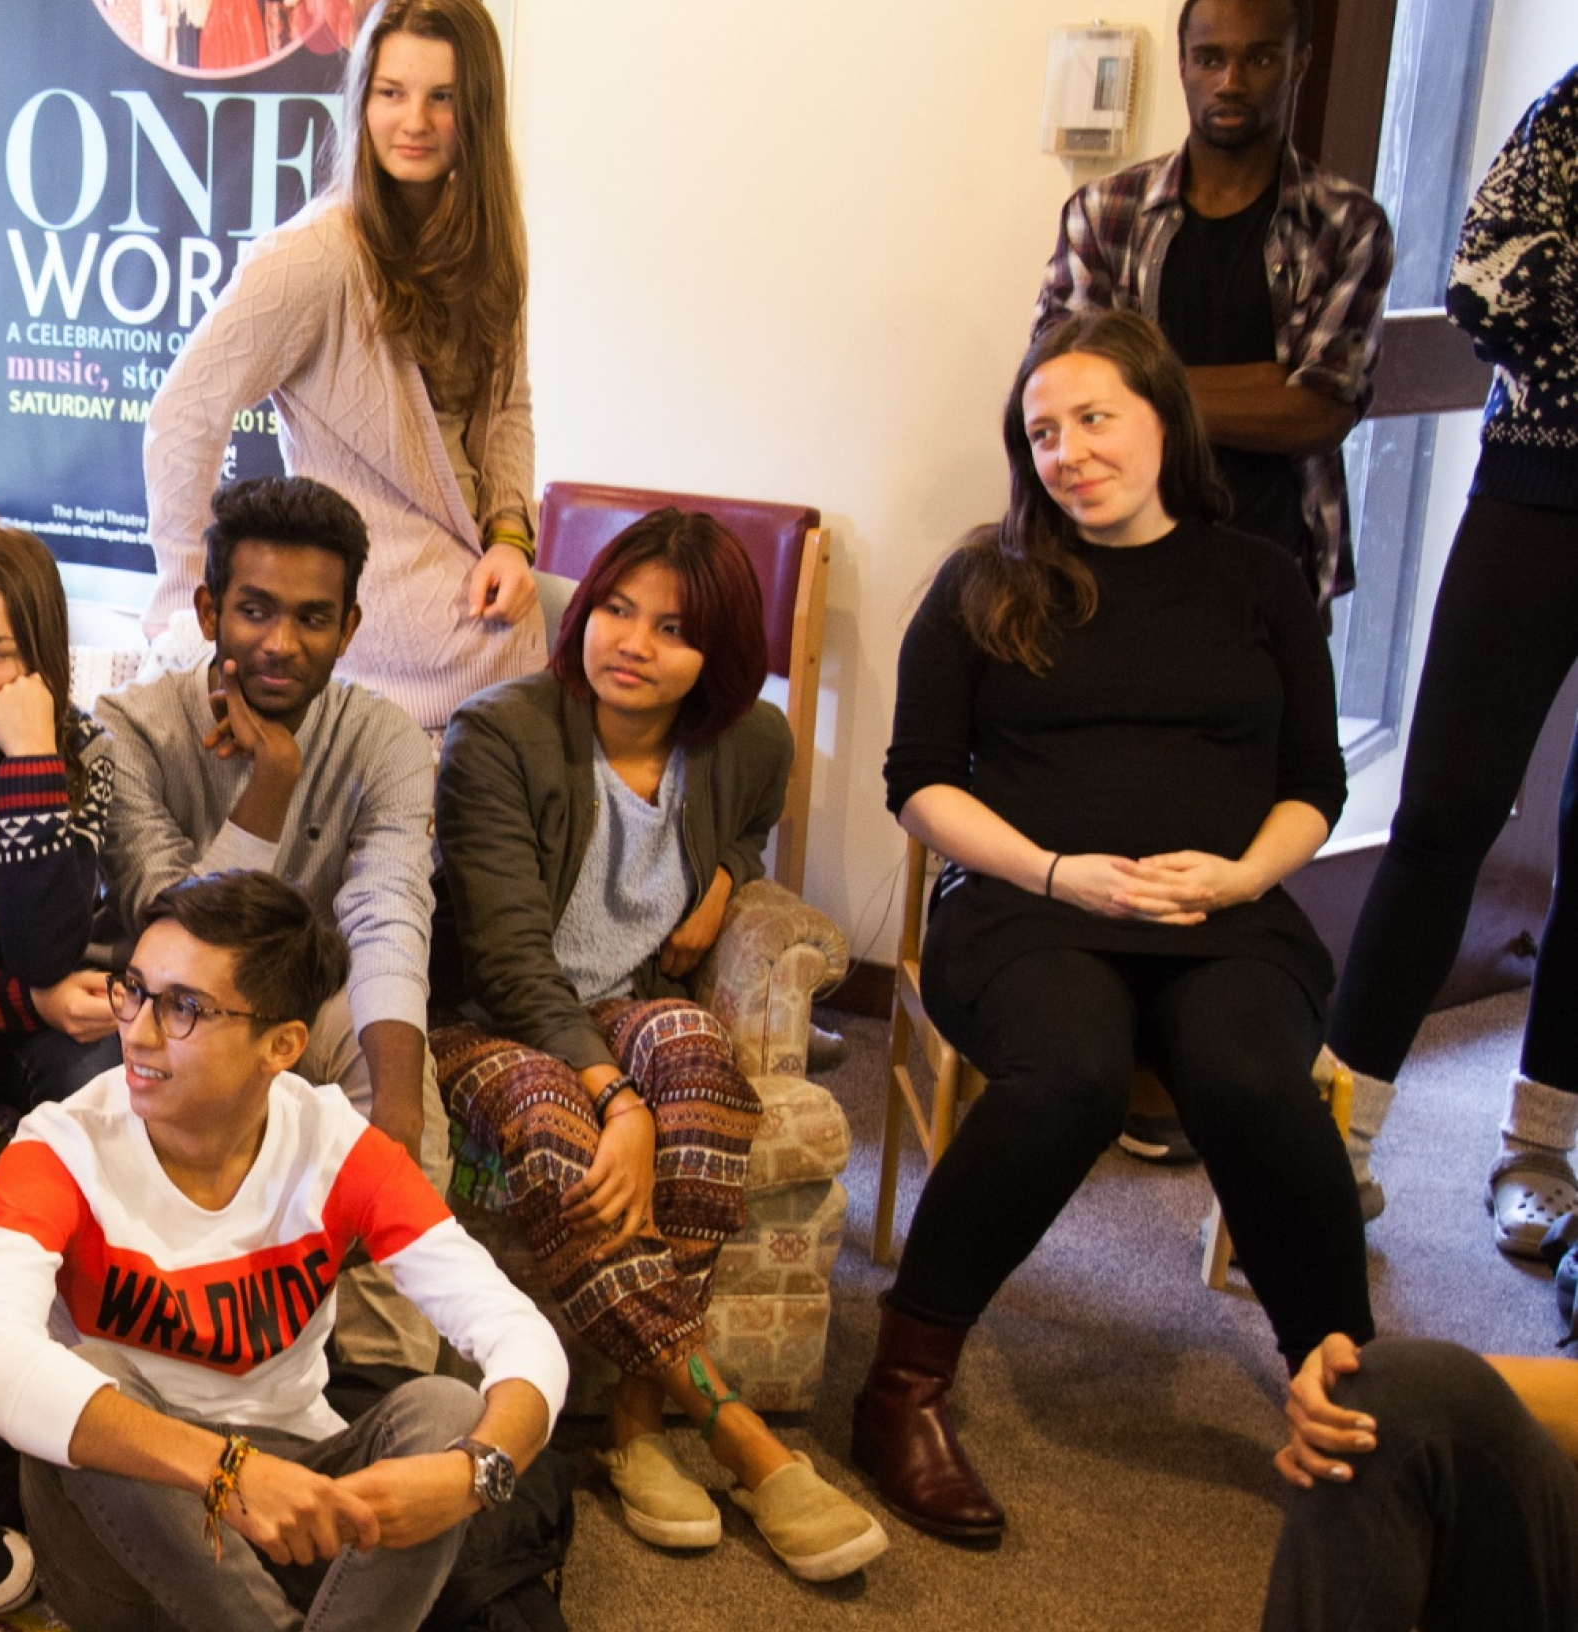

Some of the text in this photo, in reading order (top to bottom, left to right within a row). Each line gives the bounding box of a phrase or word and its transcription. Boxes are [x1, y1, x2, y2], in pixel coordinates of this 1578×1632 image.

[6, 229, 252, 328] WOR
[6, 320, 191, 355] A CELEBRATION O
[6, 350, 168, 394] music, sto
[8, 389, 116, 420] SATURDAY
[120, 398, 150, 423] MA
